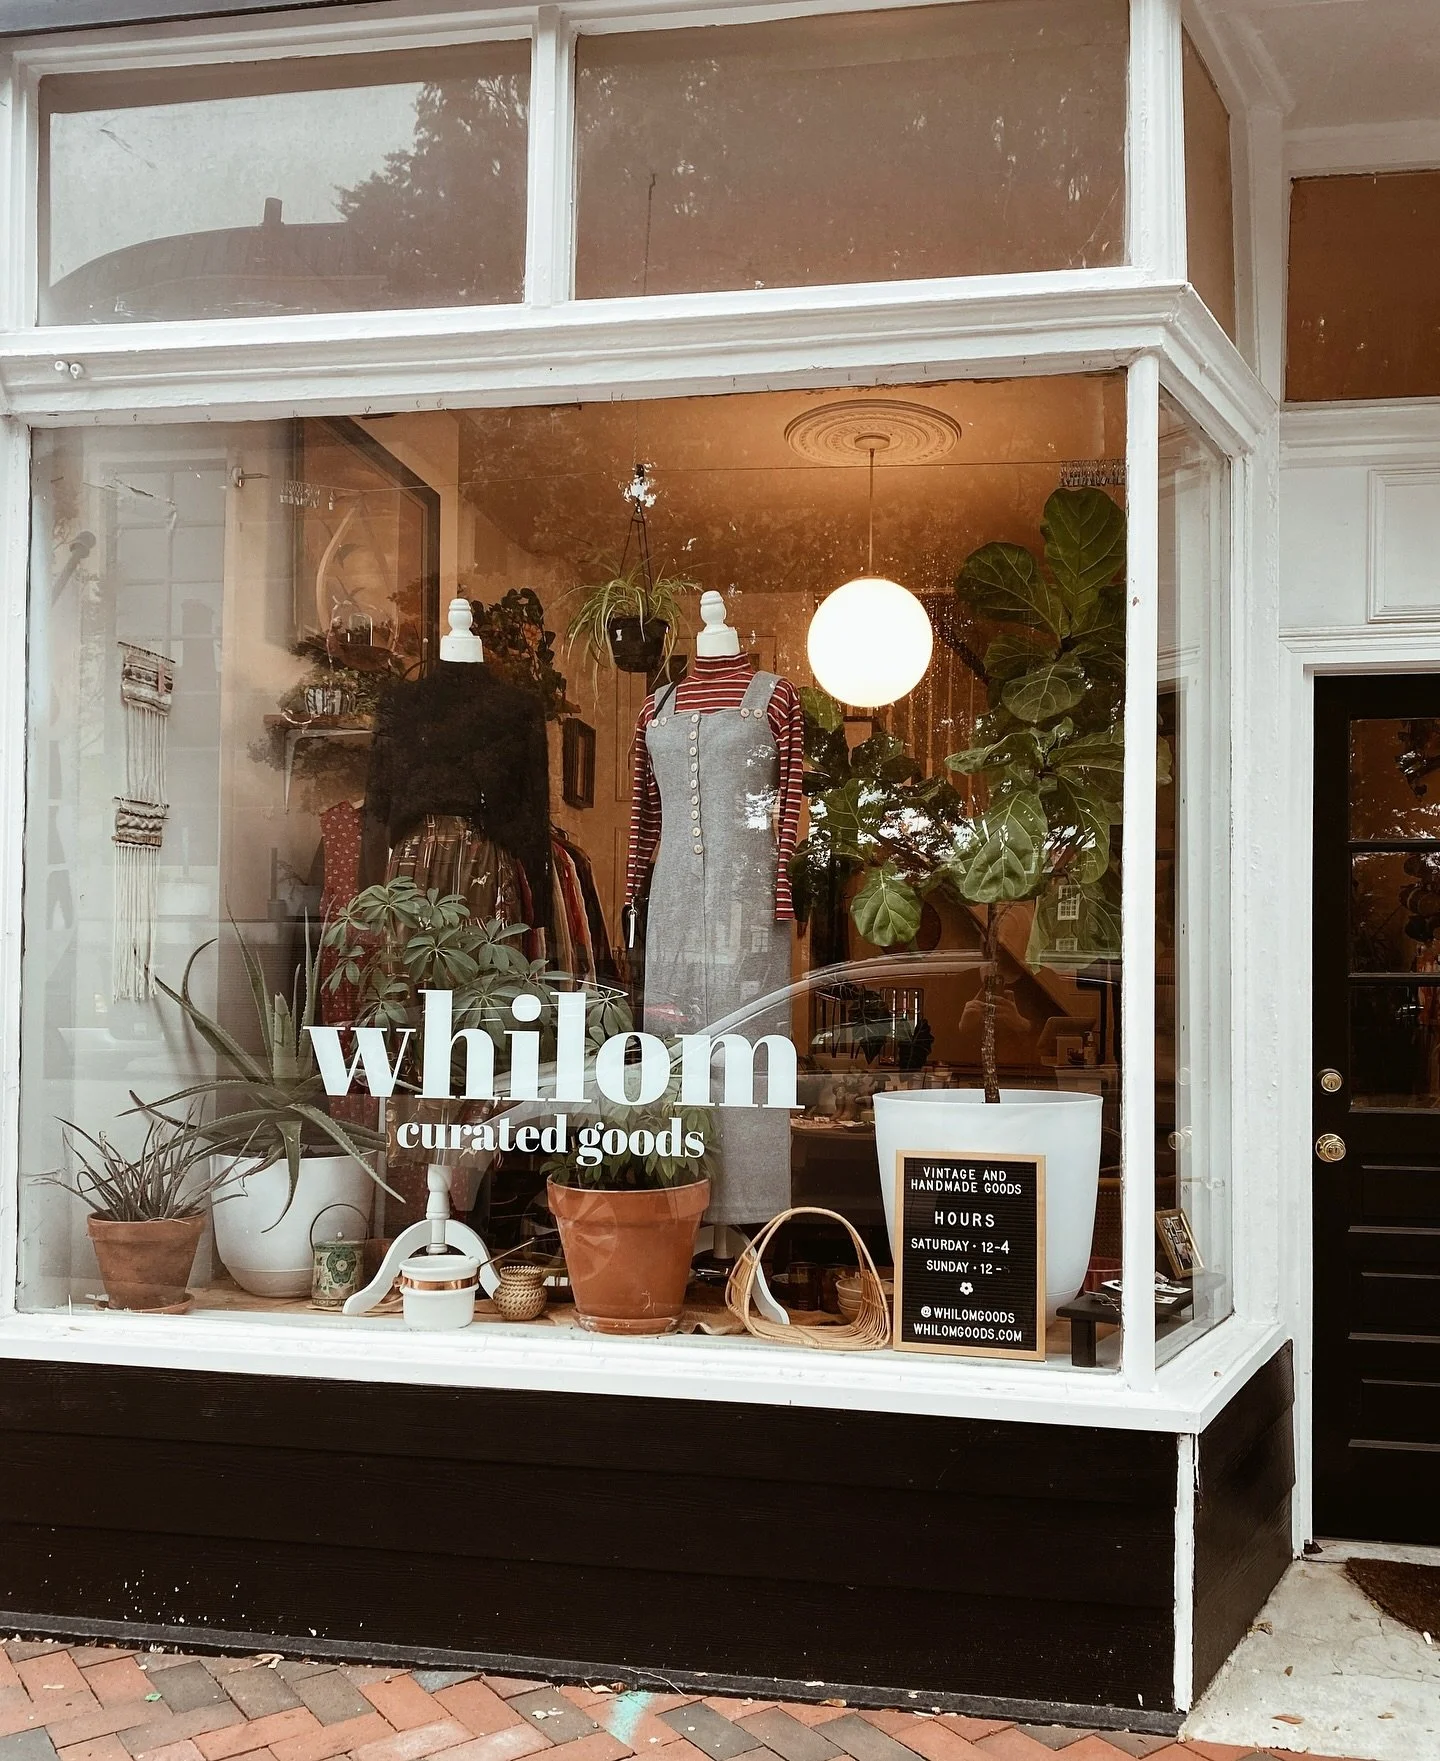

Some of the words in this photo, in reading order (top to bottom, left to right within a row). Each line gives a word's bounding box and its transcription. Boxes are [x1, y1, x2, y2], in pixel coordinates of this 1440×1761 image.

[303, 989, 805, 1109] whilom
[396, 1113, 569, 1155] curated
[577, 1116, 705, 1166] goods
[924, 1166, 976, 1180] VINTAGE
[983, 1169, 1007, 1182] AND
[911, 1179, 978, 1193] HANDMADE
[984, 1182, 1022, 1195] GOODS
[934, 1210, 995, 1228] HOURS
[911, 1237, 970, 1252] SATURDAY
[981, 1239, 1010, 1255] 12-4
[926, 1259, 969, 1273] SUNDAY
[913, 1322, 1022, 1342] WHILOMGOODS.COM
